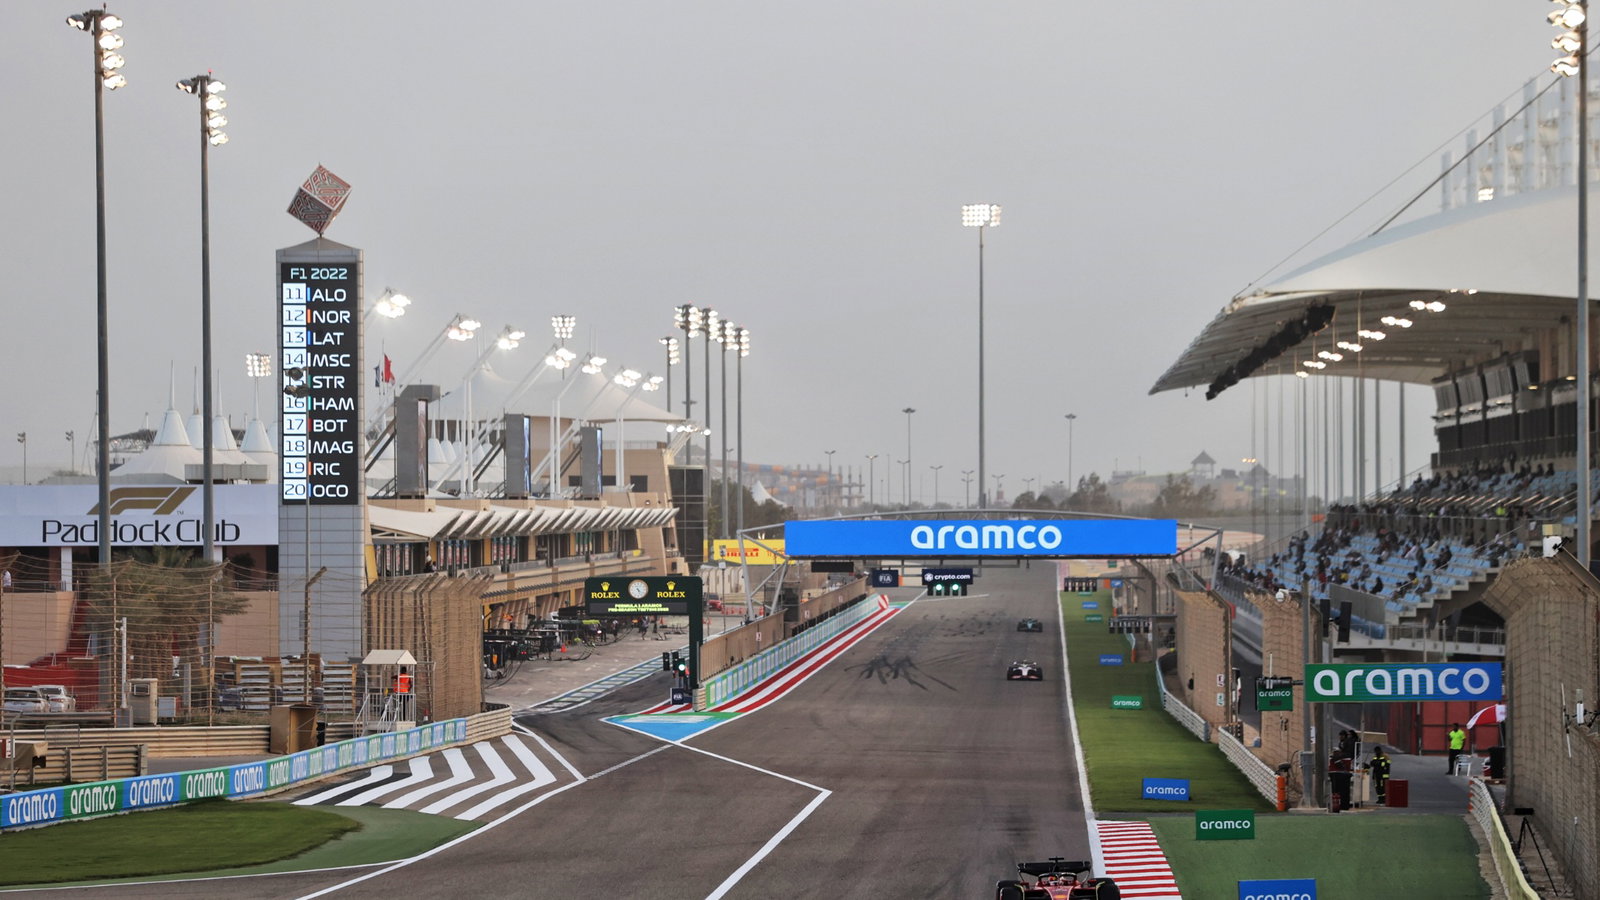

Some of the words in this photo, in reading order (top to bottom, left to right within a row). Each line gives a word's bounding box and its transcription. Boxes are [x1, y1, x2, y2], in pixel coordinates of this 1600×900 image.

[290, 267, 307, 280] F1
[311, 267, 348, 280] 2022
[286, 287, 303, 300] 11
[312, 288, 347, 302] ALO
[286, 309, 304, 322] 12
[312, 310, 351, 324] NOR
[286, 331, 304, 343] 13
[312, 332, 345, 345] LAT
[285, 353, 304, 365] 14
[312, 354, 351, 367] MSC
[312, 375, 345, 389] STR
[286, 397, 305, 409] 16
[313, 397, 355, 411] HAM
[287, 418, 304, 431] 17
[313, 419, 348, 432] BOT
[286, 440, 305, 452] 18
[313, 441, 354, 454] MAG
[286, 462, 305, 474] 19
[313, 462, 341, 476] RIC
[284, 483, 306, 496] 20
[313, 484, 349, 497] OCO
[910, 524, 1063, 549] aramco
[591, 591, 620, 599] ROLEX
[1313, 667, 1490, 696] aramco
[186, 770, 225, 799] aramco
[234, 765, 264, 793] aramco
[129, 776, 174, 807] aramco
[1145, 785, 1186, 795] aramco
[70, 784, 117, 815] aramco
[8, 792, 57, 824] aramco
[1200, 819, 1251, 830] aramco
